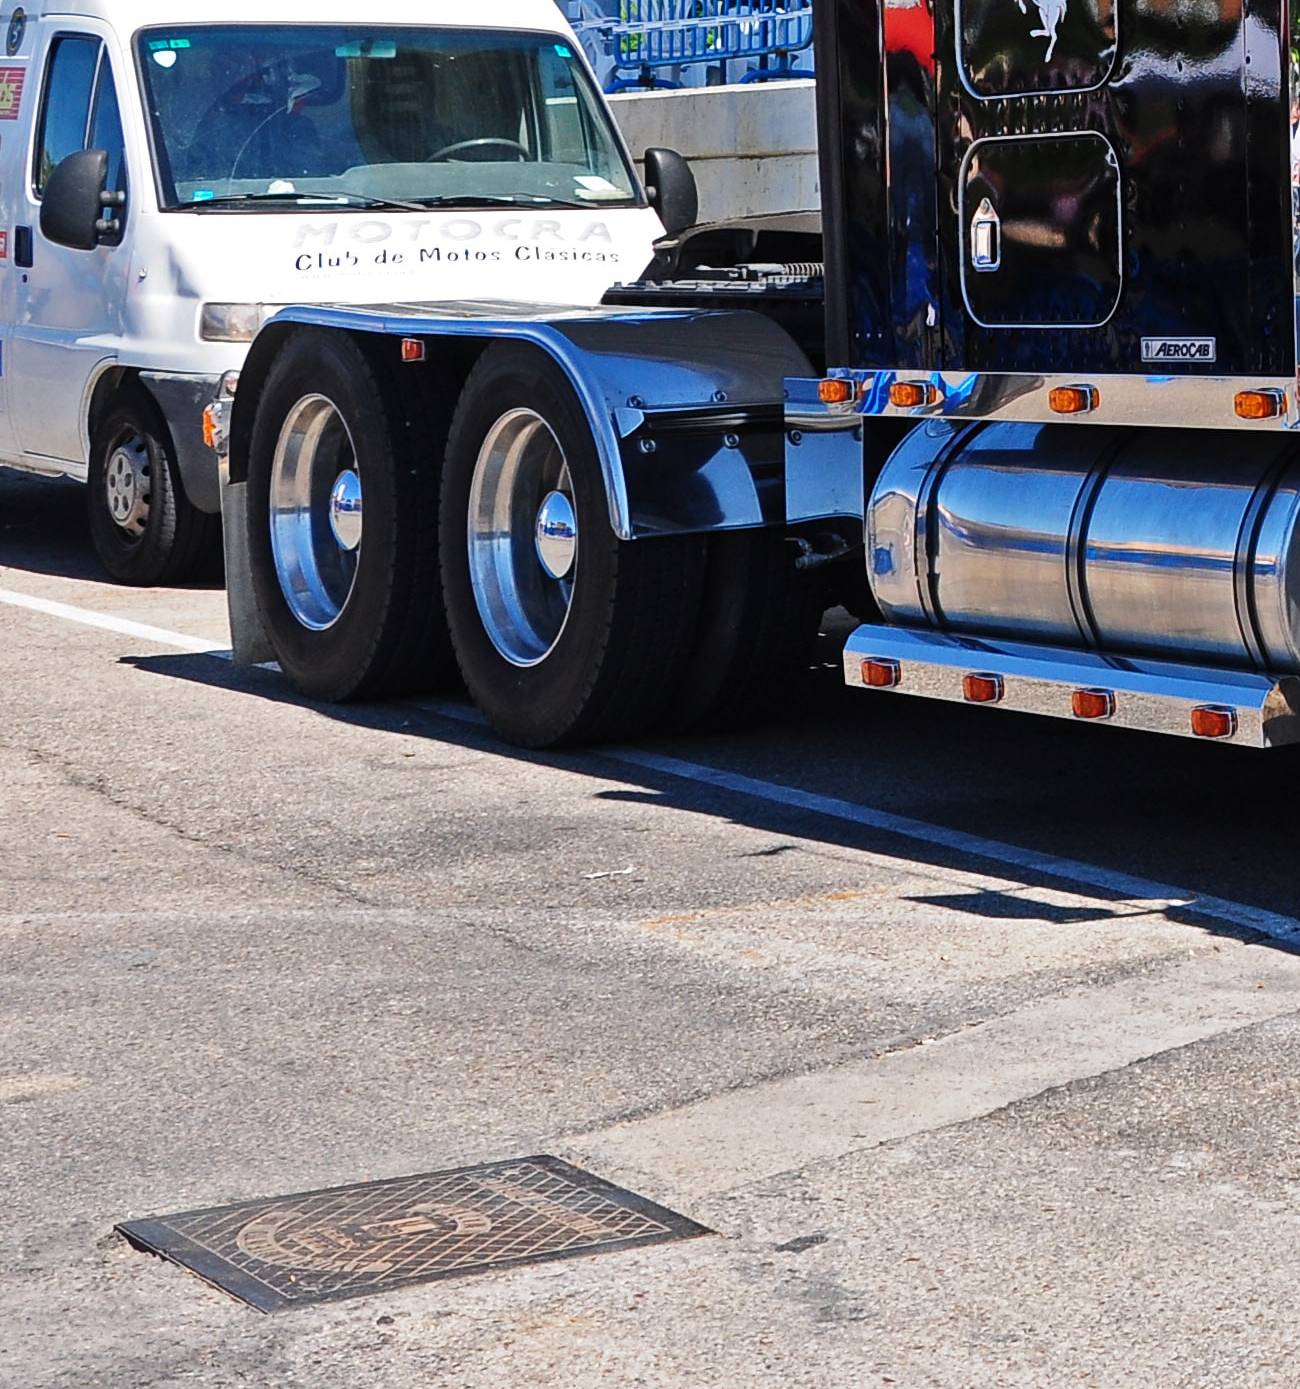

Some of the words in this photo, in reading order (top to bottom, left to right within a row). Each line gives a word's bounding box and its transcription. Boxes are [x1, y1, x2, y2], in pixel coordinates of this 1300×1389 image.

[293, 218, 614, 248] MOTOCRA
[374, 249, 404, 265] de
[420, 247, 502, 263] Motos
